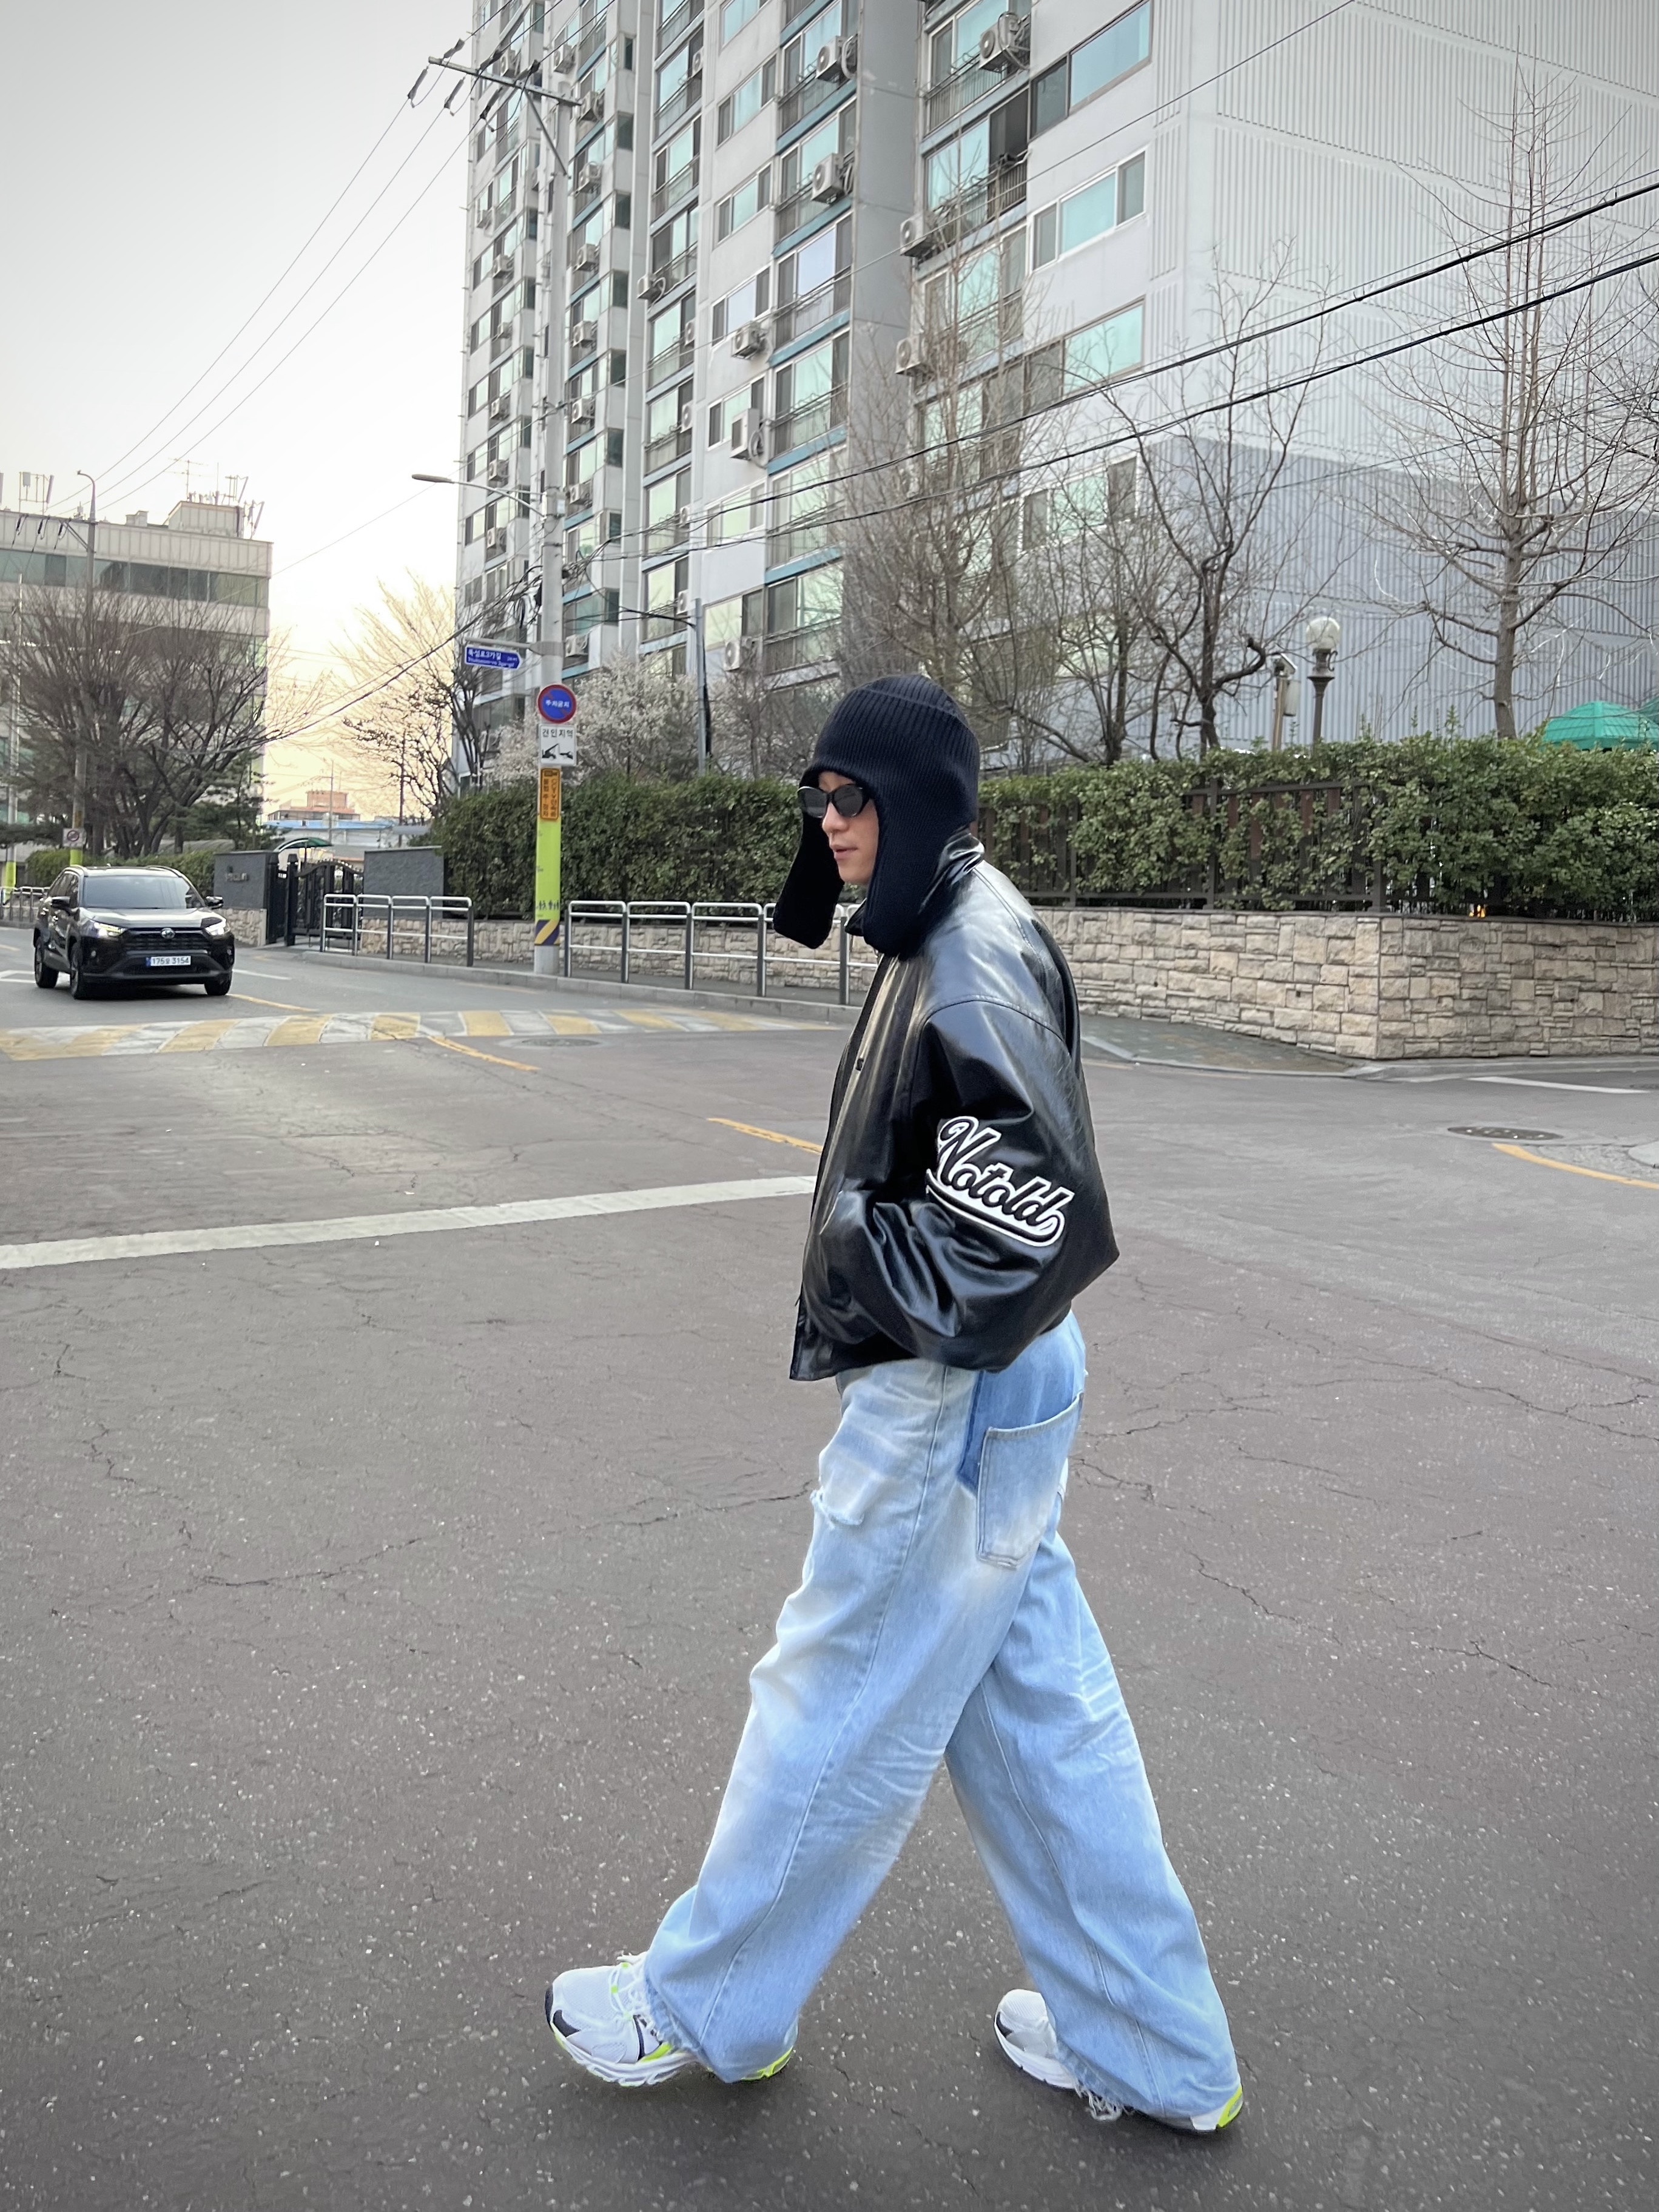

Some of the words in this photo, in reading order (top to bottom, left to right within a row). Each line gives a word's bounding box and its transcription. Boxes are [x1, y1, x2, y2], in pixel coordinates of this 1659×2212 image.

[545, 699, 570, 708] 주차금지
[542, 729, 573, 738] 견인지역
[172, 956, 189, 965] 3154
